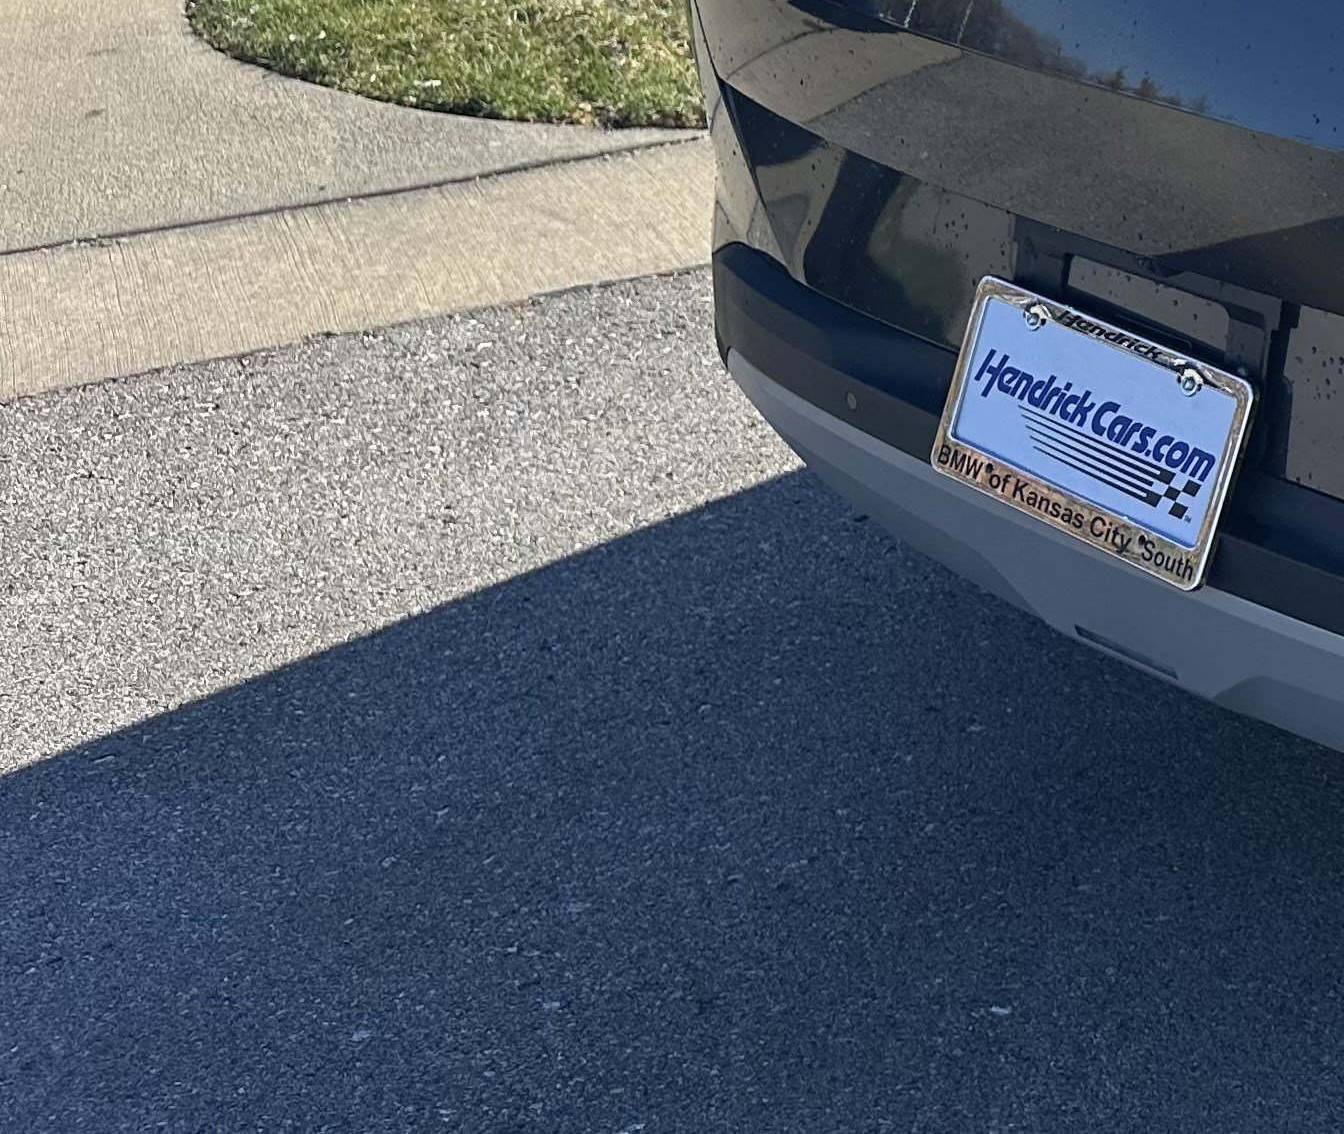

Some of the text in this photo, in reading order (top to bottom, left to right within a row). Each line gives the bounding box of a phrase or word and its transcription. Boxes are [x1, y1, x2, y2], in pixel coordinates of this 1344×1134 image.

[1056, 309, 1164, 360] Hendrick
[974, 347, 1217, 483] HendrickCars.com
[937, 443, 1194, 583] BMW of Kansas City South
